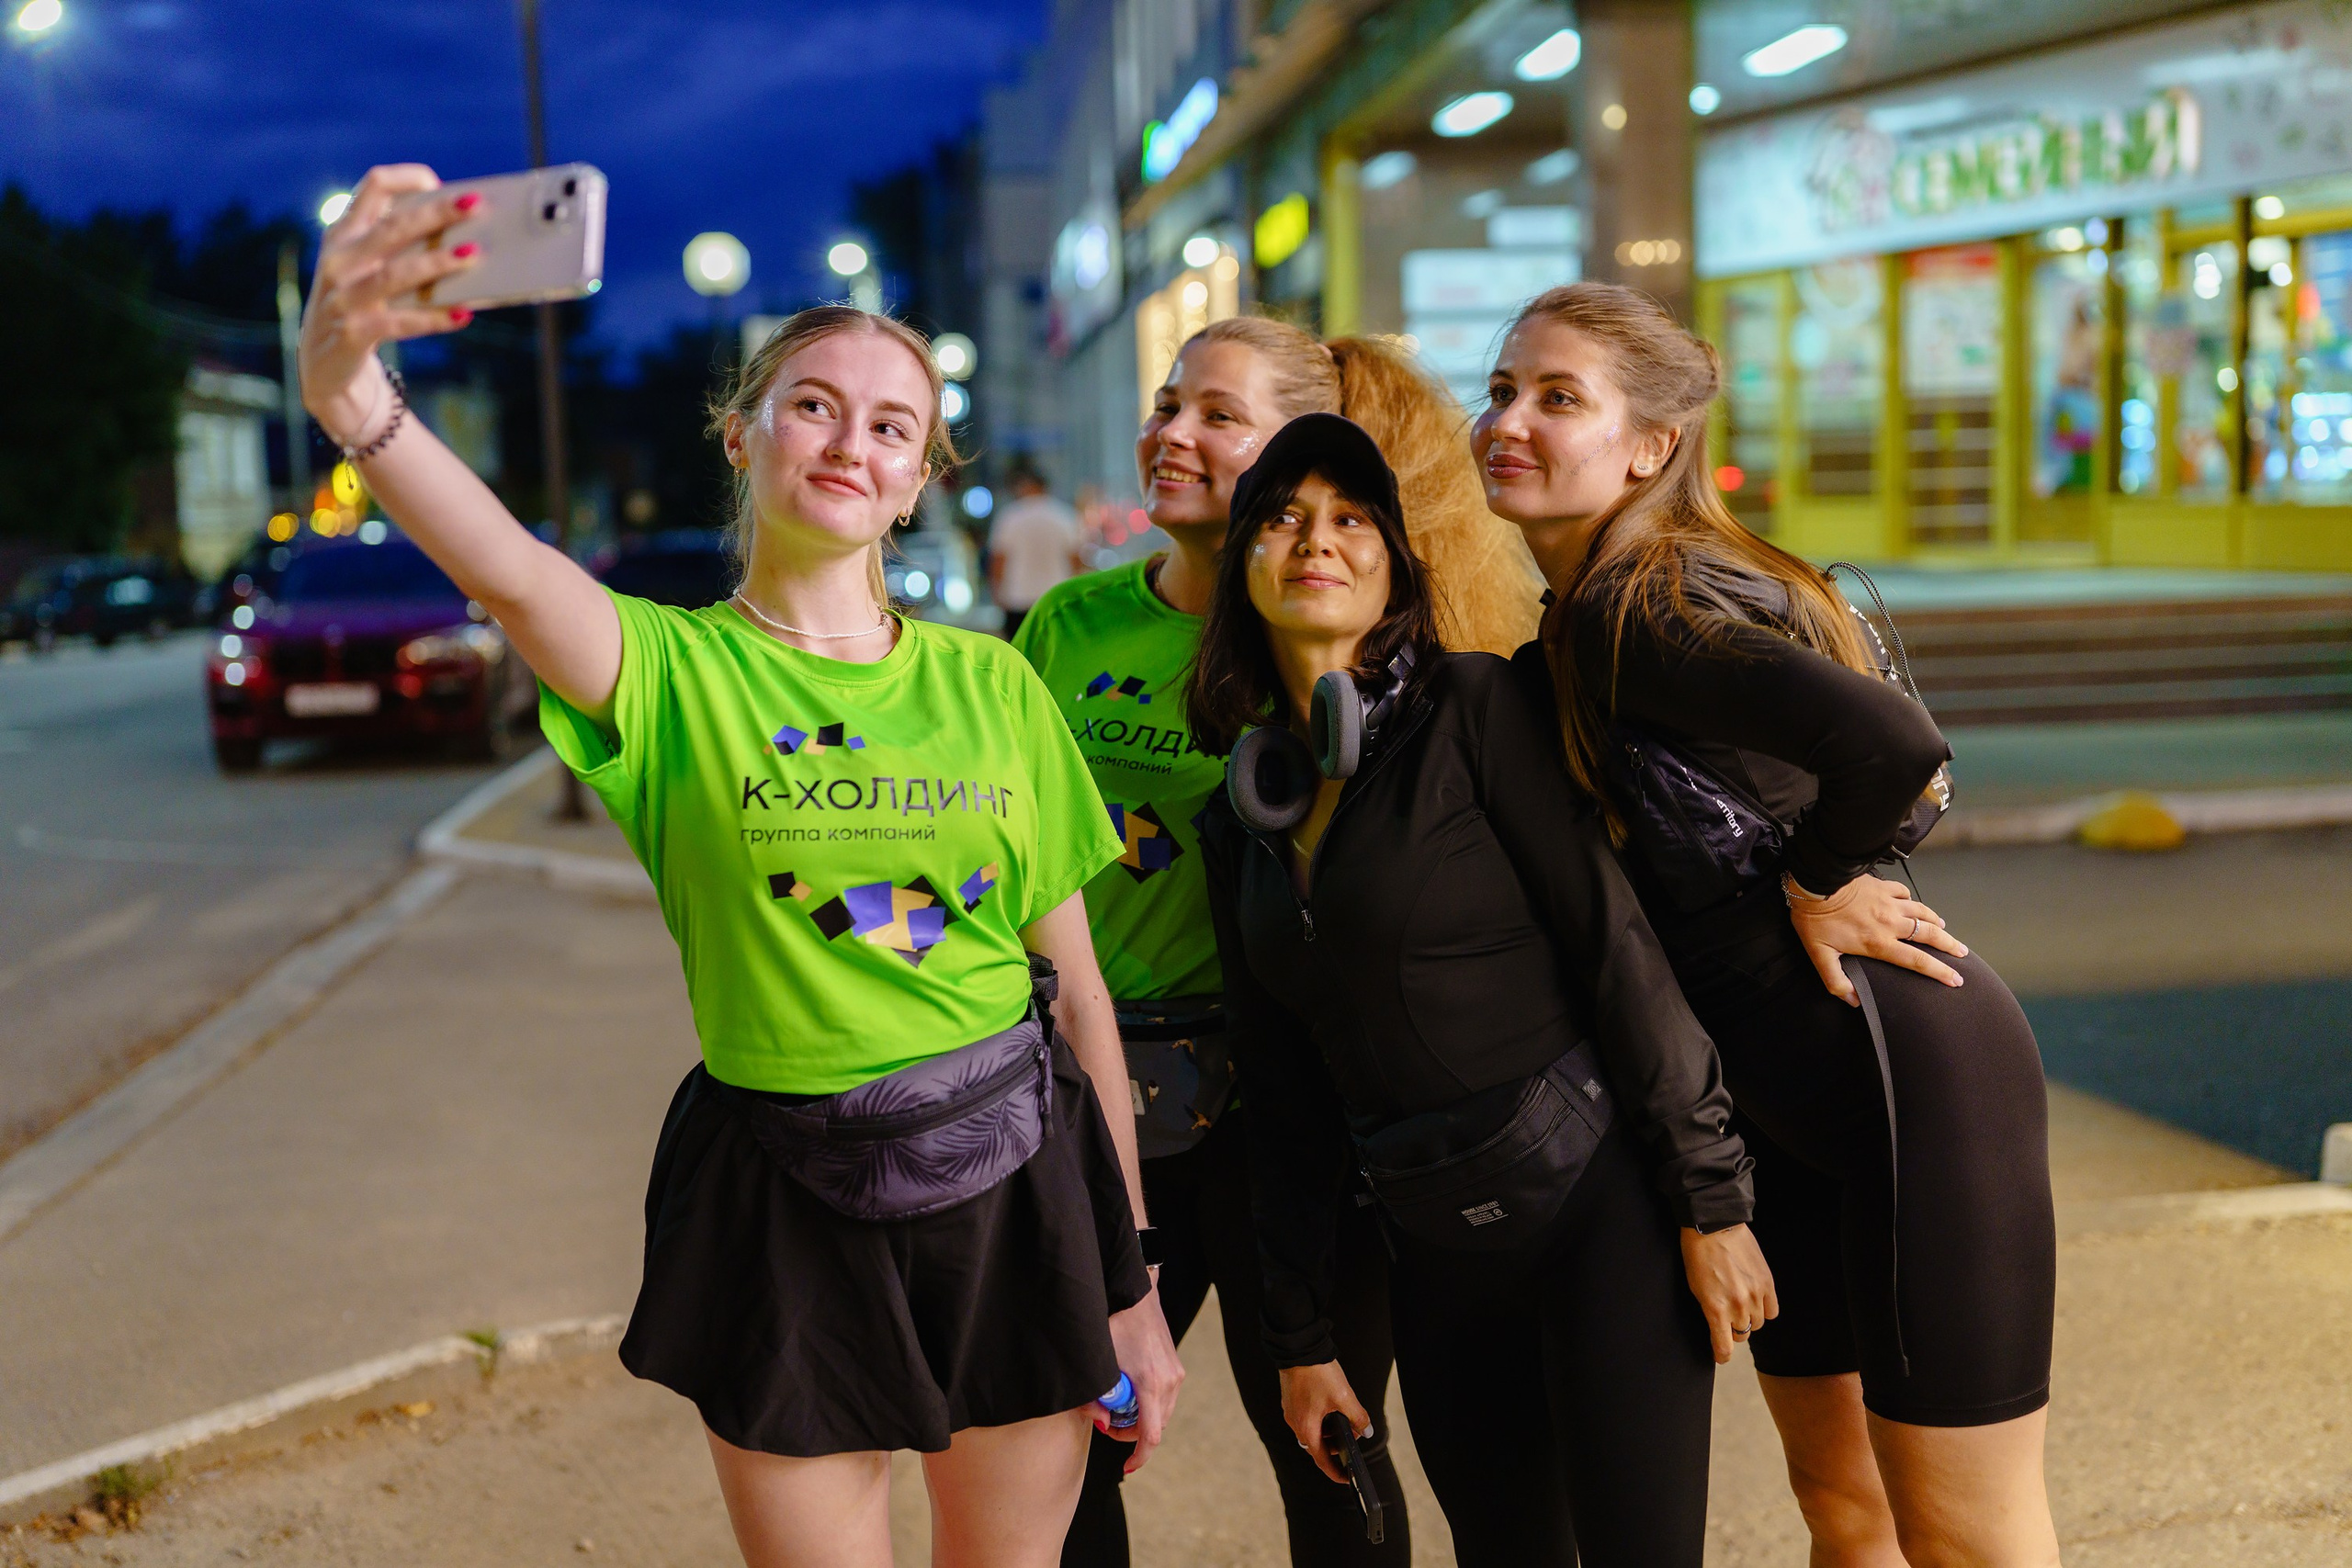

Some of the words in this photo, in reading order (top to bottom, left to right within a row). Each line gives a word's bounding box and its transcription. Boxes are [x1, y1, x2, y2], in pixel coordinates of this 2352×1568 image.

[1087, 754, 1172, 775] компаний
[742, 776, 1012, 818] К-ХОЛДИНГ
[1713, 796, 1744, 838] erritory
[741, 829, 820, 845] группа
[828, 825, 935, 841] компаний
